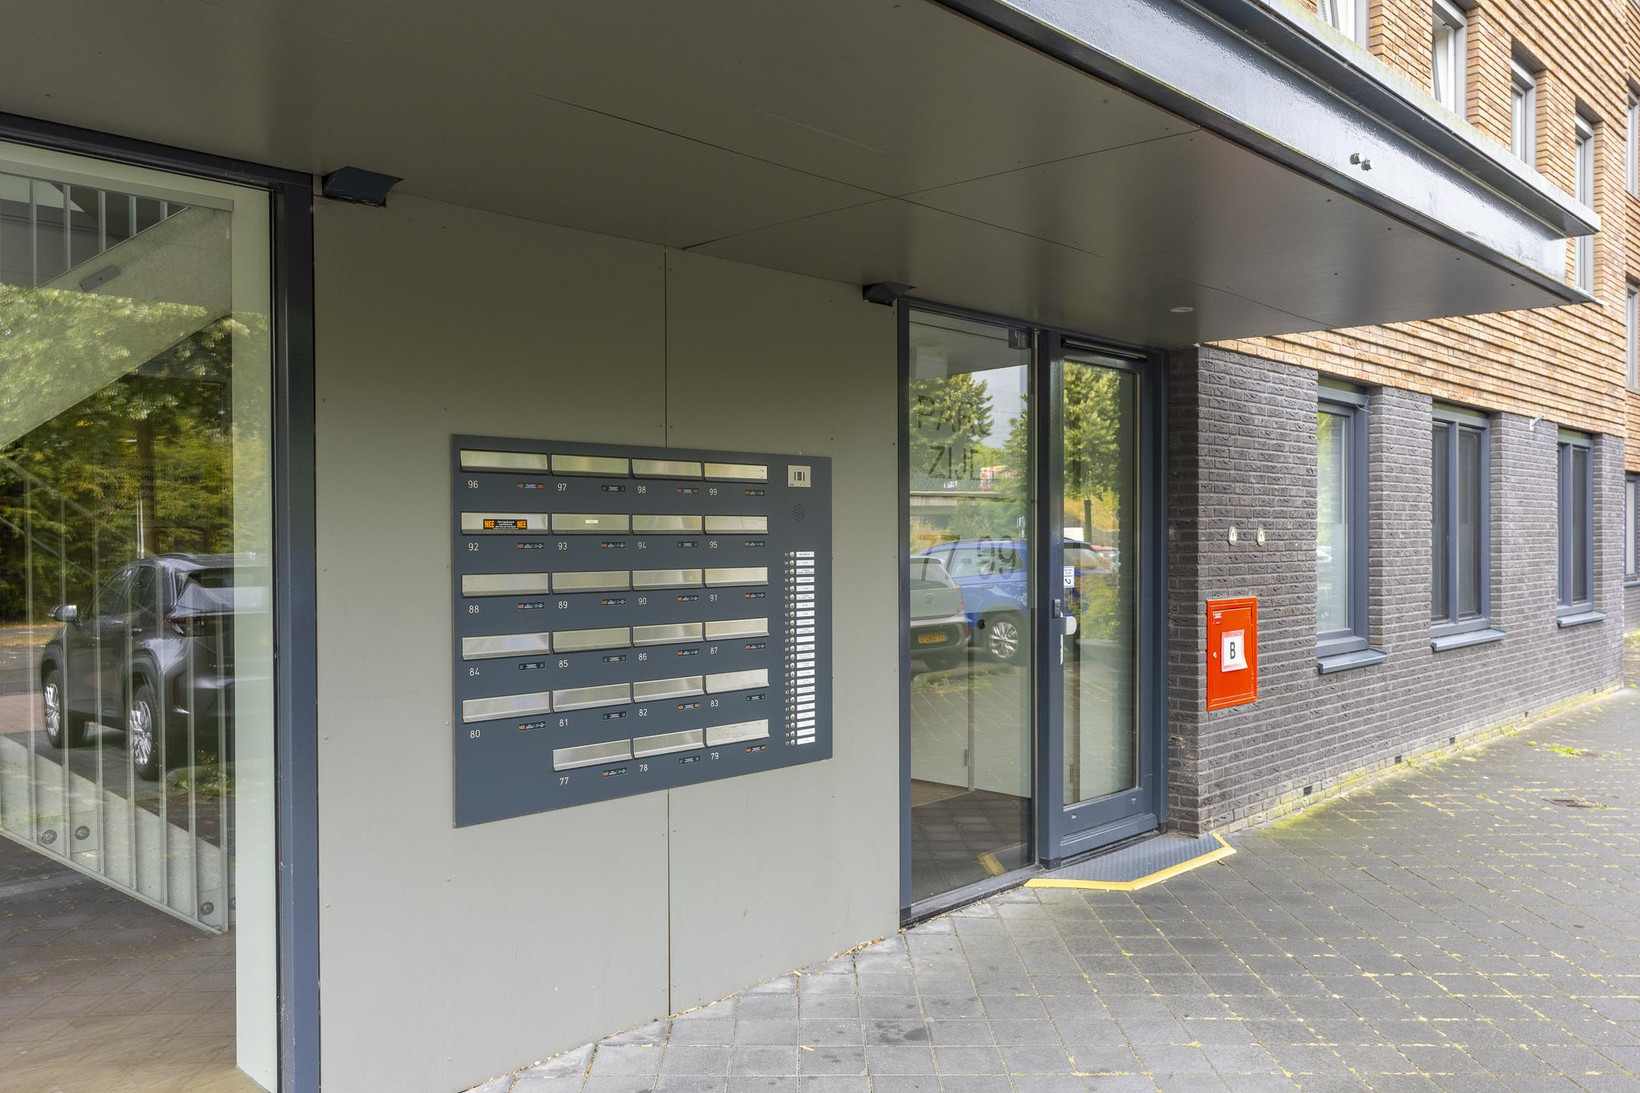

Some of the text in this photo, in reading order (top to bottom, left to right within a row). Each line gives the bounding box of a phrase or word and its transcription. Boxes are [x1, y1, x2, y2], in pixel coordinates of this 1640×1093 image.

[467, 479, 479, 489] 96
[557, 482, 567, 492] 97
[637, 485, 647, 494] 98
[709, 487, 718, 496] 99
[484, 520, 495, 528] NEE
[516, 520, 527, 528] NEE
[468, 542, 479, 552] 92
[557, 541, 568, 551] 93
[709, 540, 718, 549] 95
[637, 596, 647, 606] 90
[709, 593, 718, 602] 91
[468, 604, 480, 614] 88
[558, 600, 568, 610] 89
[709, 646, 719, 655] 87
[1229, 641, 1236, 660] B
[638, 652, 648, 661] 86
[558, 659, 569, 668] 85
[469, 667, 480, 677] 84
[710, 699, 719, 708] 83
[638, 708, 648, 717] 82
[558, 718, 568, 728] 81
[469, 729, 481, 739] 80
[710, 751, 719, 760] 79
[639, 763, 649, 772] 78
[559, 776, 569, 786] 77
